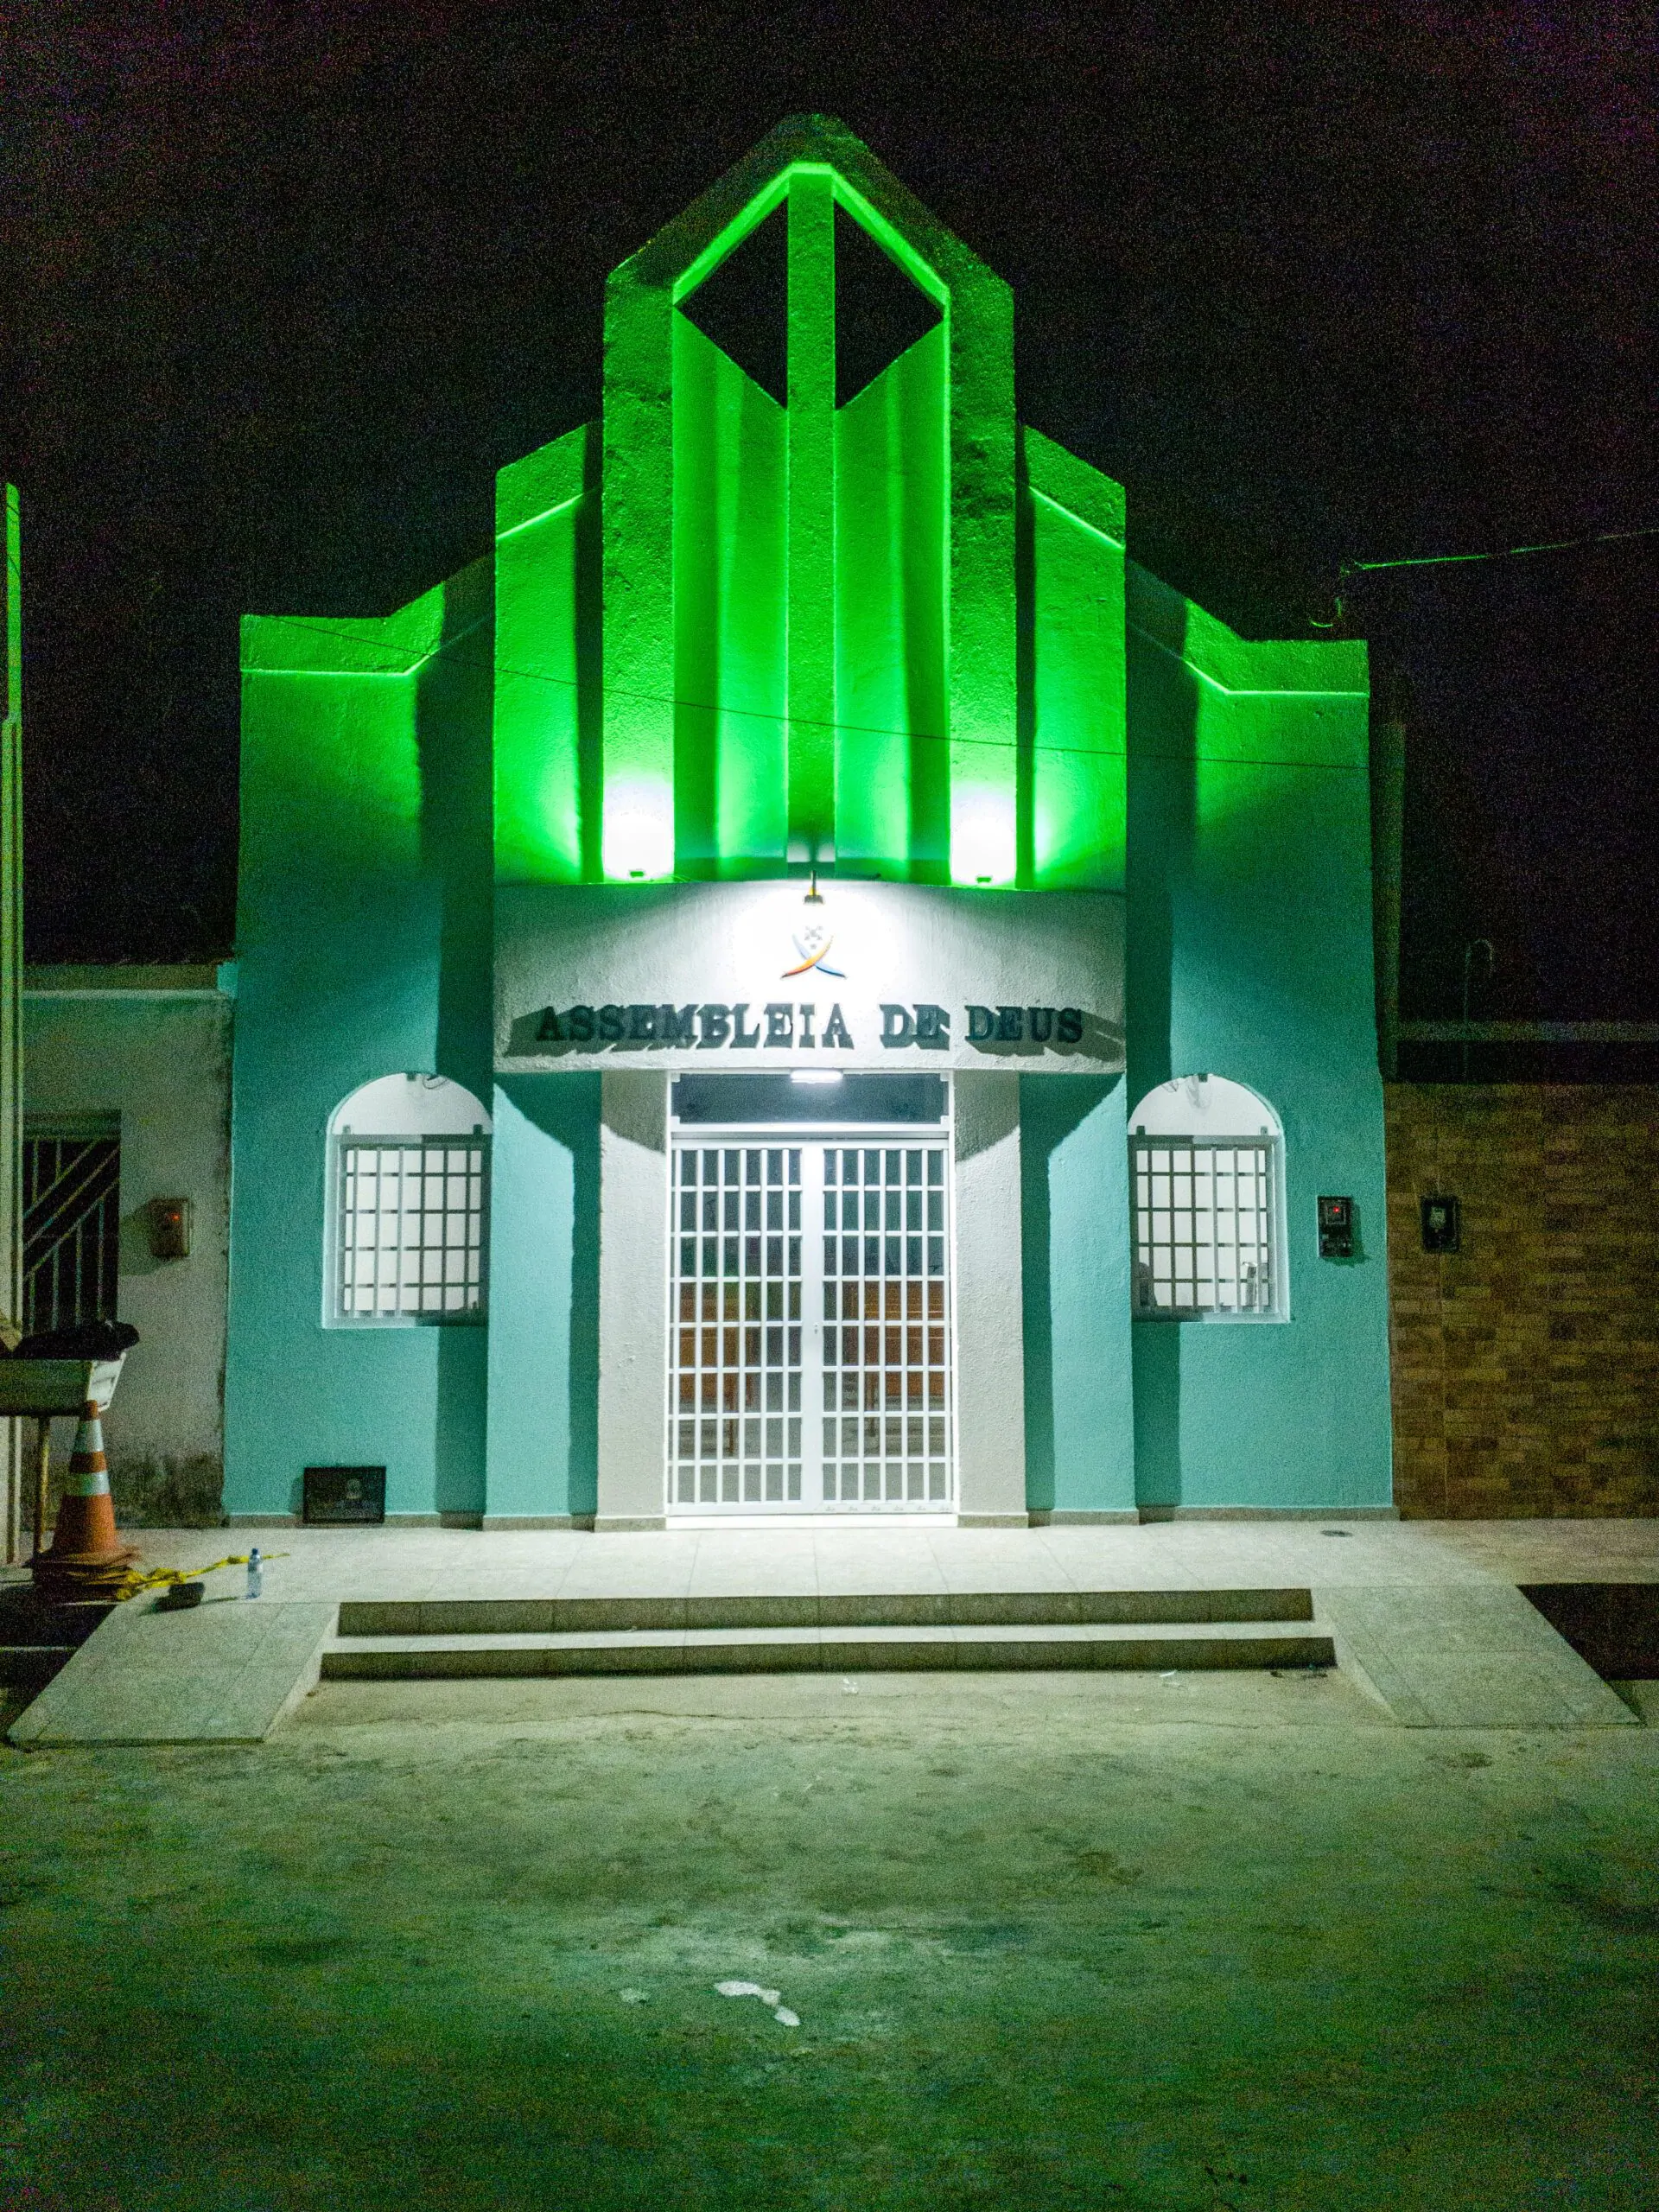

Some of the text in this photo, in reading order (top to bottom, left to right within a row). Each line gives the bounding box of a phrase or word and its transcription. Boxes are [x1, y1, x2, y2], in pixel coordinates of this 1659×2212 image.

[535, 1002, 1084, 1045] ASSEMBLEIA DE DEUS
